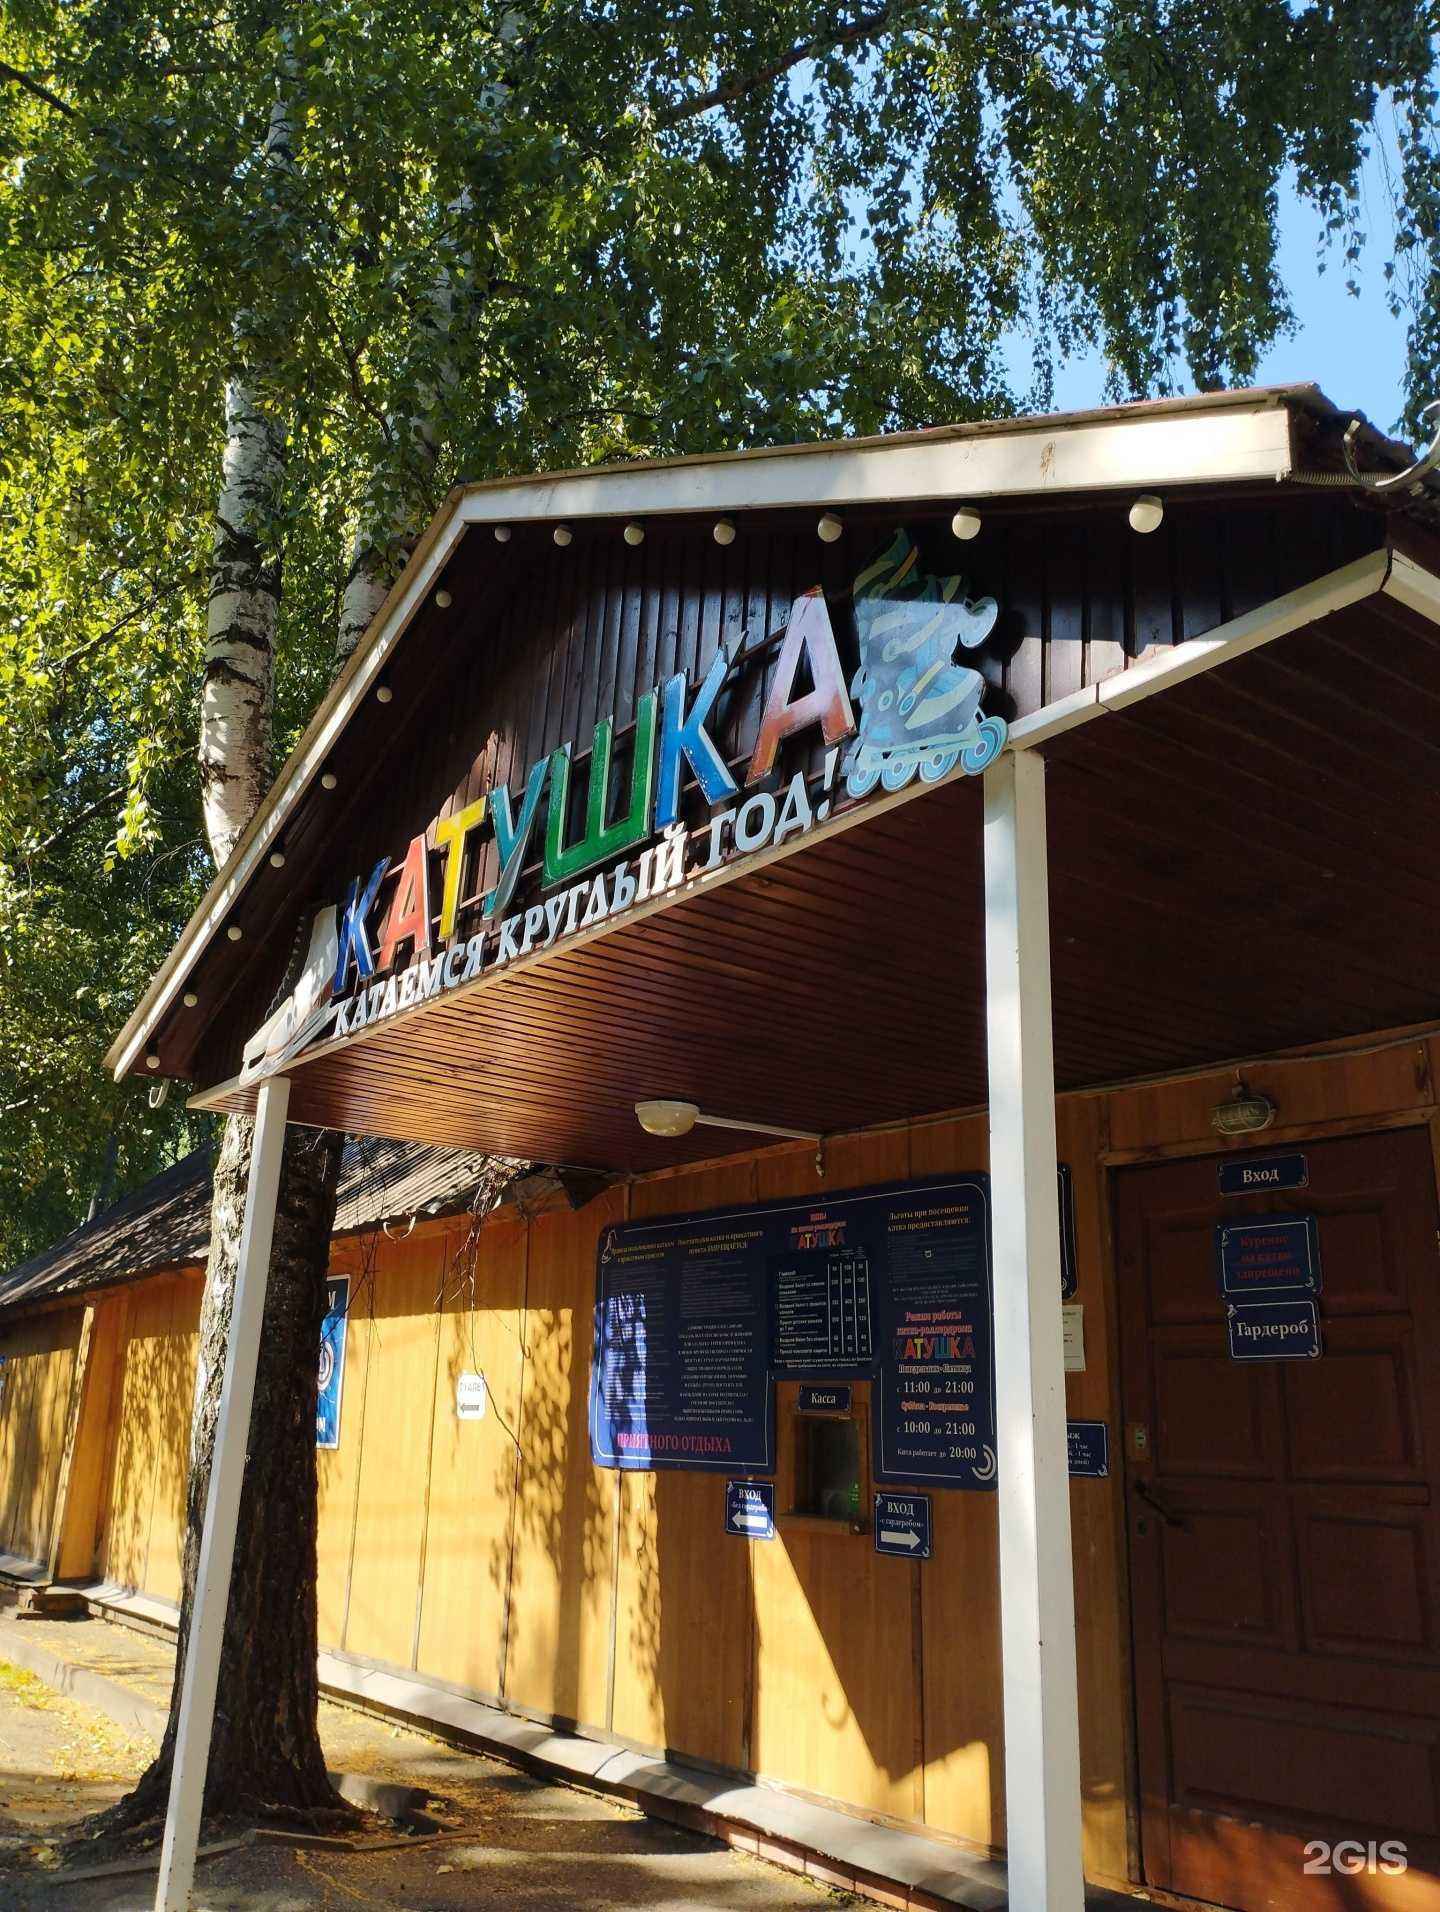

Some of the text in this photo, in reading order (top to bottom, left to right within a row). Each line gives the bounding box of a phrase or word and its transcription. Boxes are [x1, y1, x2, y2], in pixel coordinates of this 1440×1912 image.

[332, 584, 856, 996] КАТУШКА
[332, 747, 839, 1039] КАТАЕМСЯ КРУГЛЫЙ ГОД!
[1242, 1167, 1280, 1184] Вход
[1236, 1318, 1309, 1339] Гардероб
[893, 1336, 977, 1360] КАТУШКА
[904, 1381, 931, 1393] 11:00
[945, 1381, 975, 1393] 21:00
[811, 1392, 836, 1405] Касса
[904, 1421, 931, 1434] 10:00
[945, 1422, 975, 1435] 21:00
[617, 1432, 732, 1454] ПРИЯТНОГО ОТДЫХА
[950, 1446, 977, 1460] 20:00
[738, 1488, 762, 1503] ВХОД
[887, 1501, 915, 1518] ВХОД
